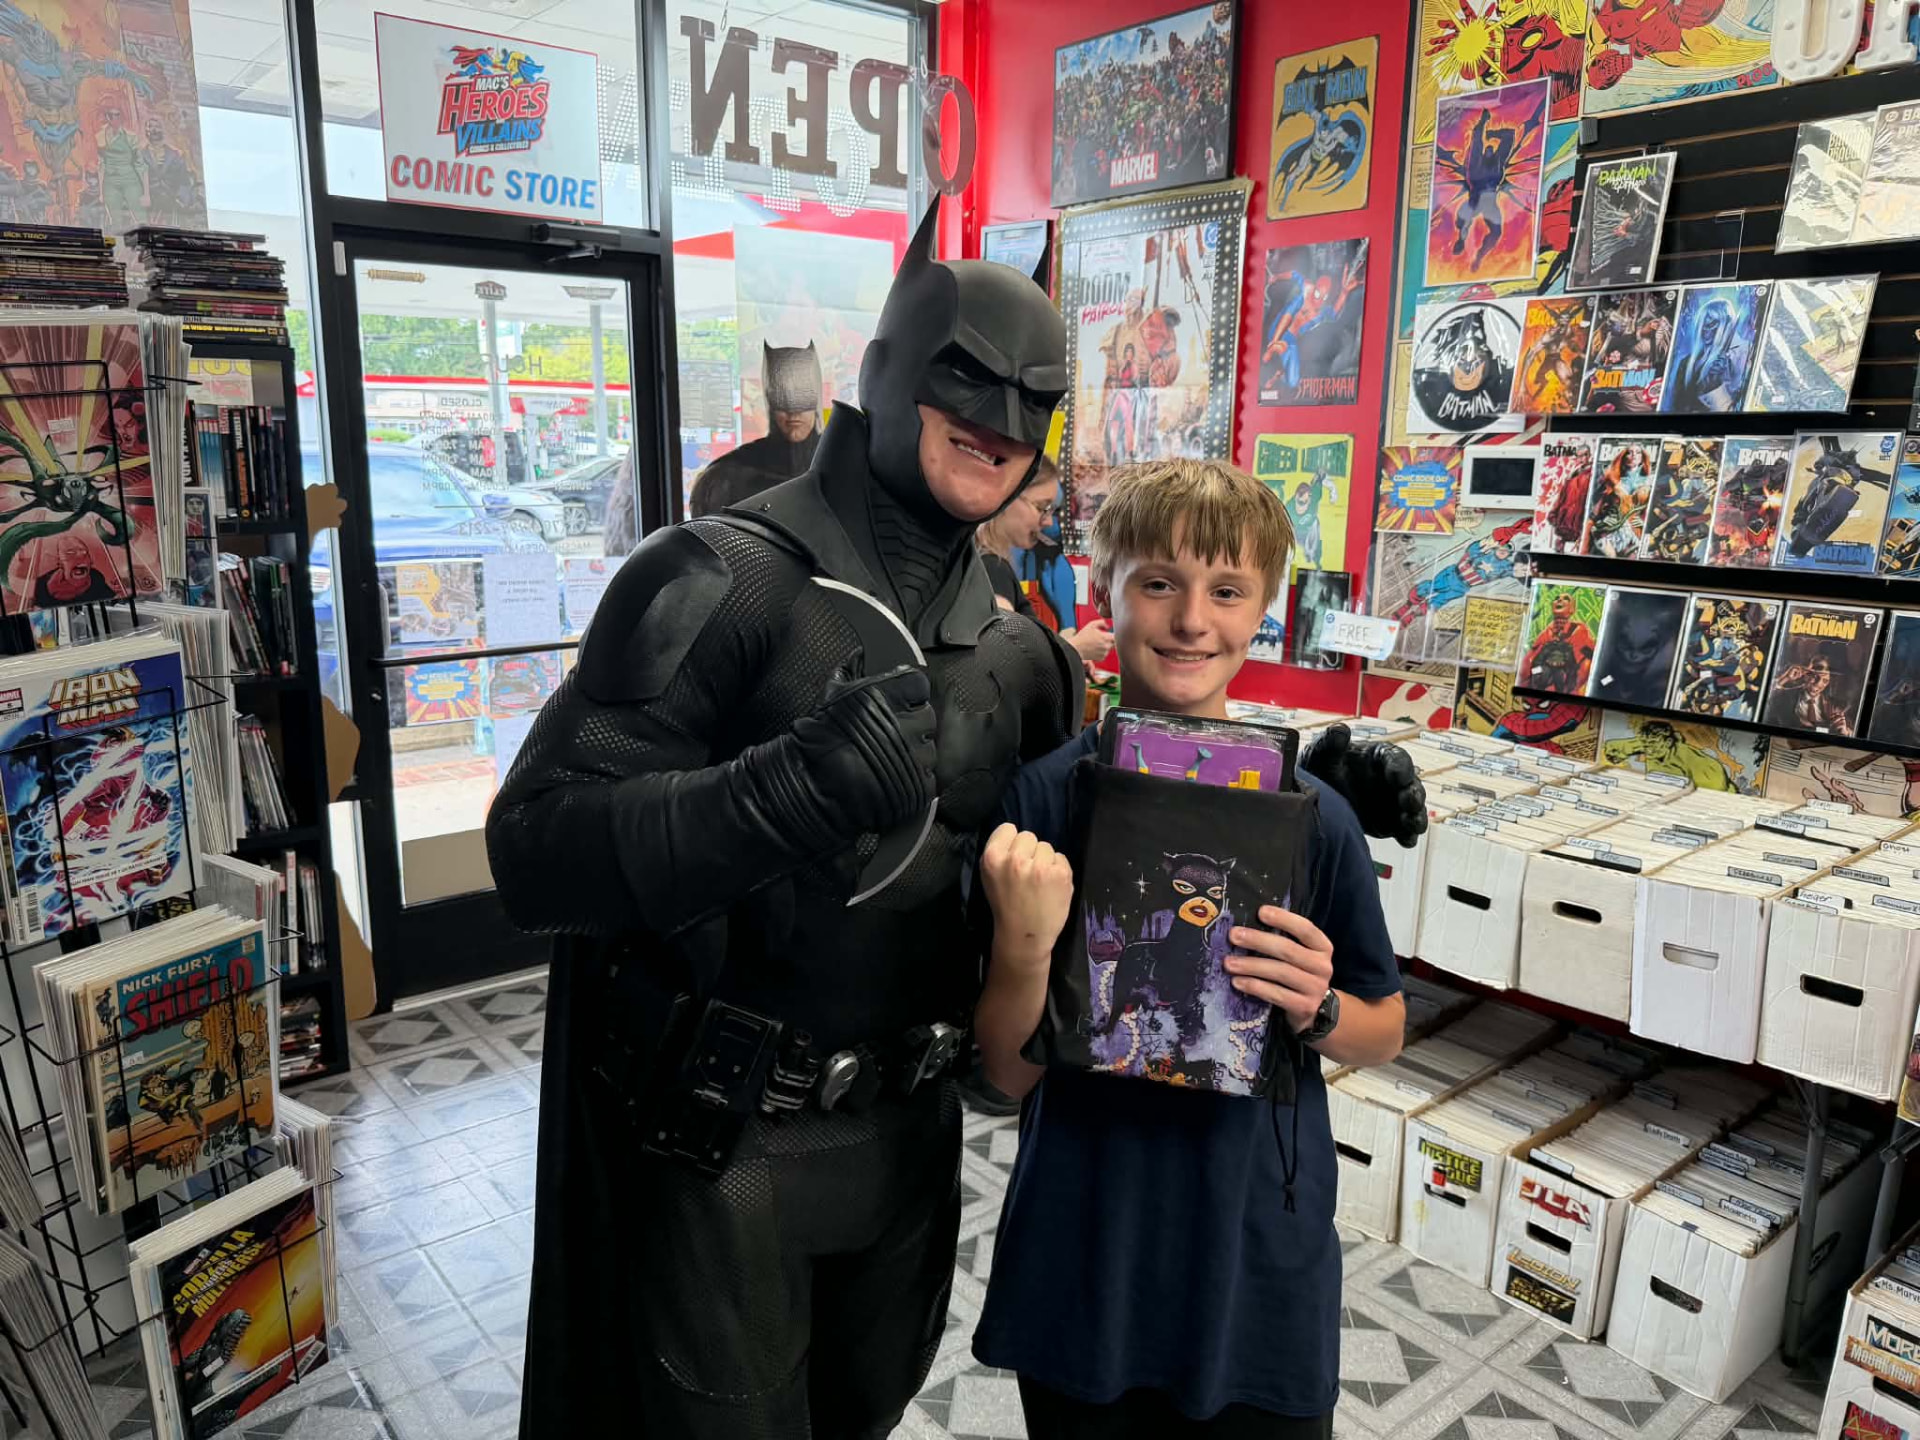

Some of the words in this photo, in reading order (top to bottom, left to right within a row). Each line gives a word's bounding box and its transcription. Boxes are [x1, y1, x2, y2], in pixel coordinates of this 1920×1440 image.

[475, 76, 510, 91] MAC'S
[1283, 76, 1318, 113] BAT
[1324, 67, 1368, 102] MAN
[441, 84, 547, 133] HEROES
[456, 118, 542, 152] VILLAINS
[390, 155, 495, 198] COMIC
[504, 169, 597, 210] STORE
[1110, 152, 1158, 187] MARVEL
[1597, 164, 1657, 186] BATMAN
[1080, 272, 1131, 305] DOOM
[1294, 375, 1356, 400] SPIDER-MAN
[1438, 390, 1497, 421] BATMAN
[1338, 622, 1372, 642] FREE
[1788, 613, 1859, 640] BATMAN
[48, 667, 141, 706] IRON
[57, 689, 140, 726] MAN
[122, 973, 162, 995] NICK
[167, 954, 213, 979] FURY
[126, 957, 254, 1040] SHIELD
[1422, 1140, 1481, 1175] JUSTICE
[1520, 1182, 1591, 1225] JLA
[173, 1229, 255, 1315] GODZILLA
[1510, 1249, 1581, 1290] LEGION
